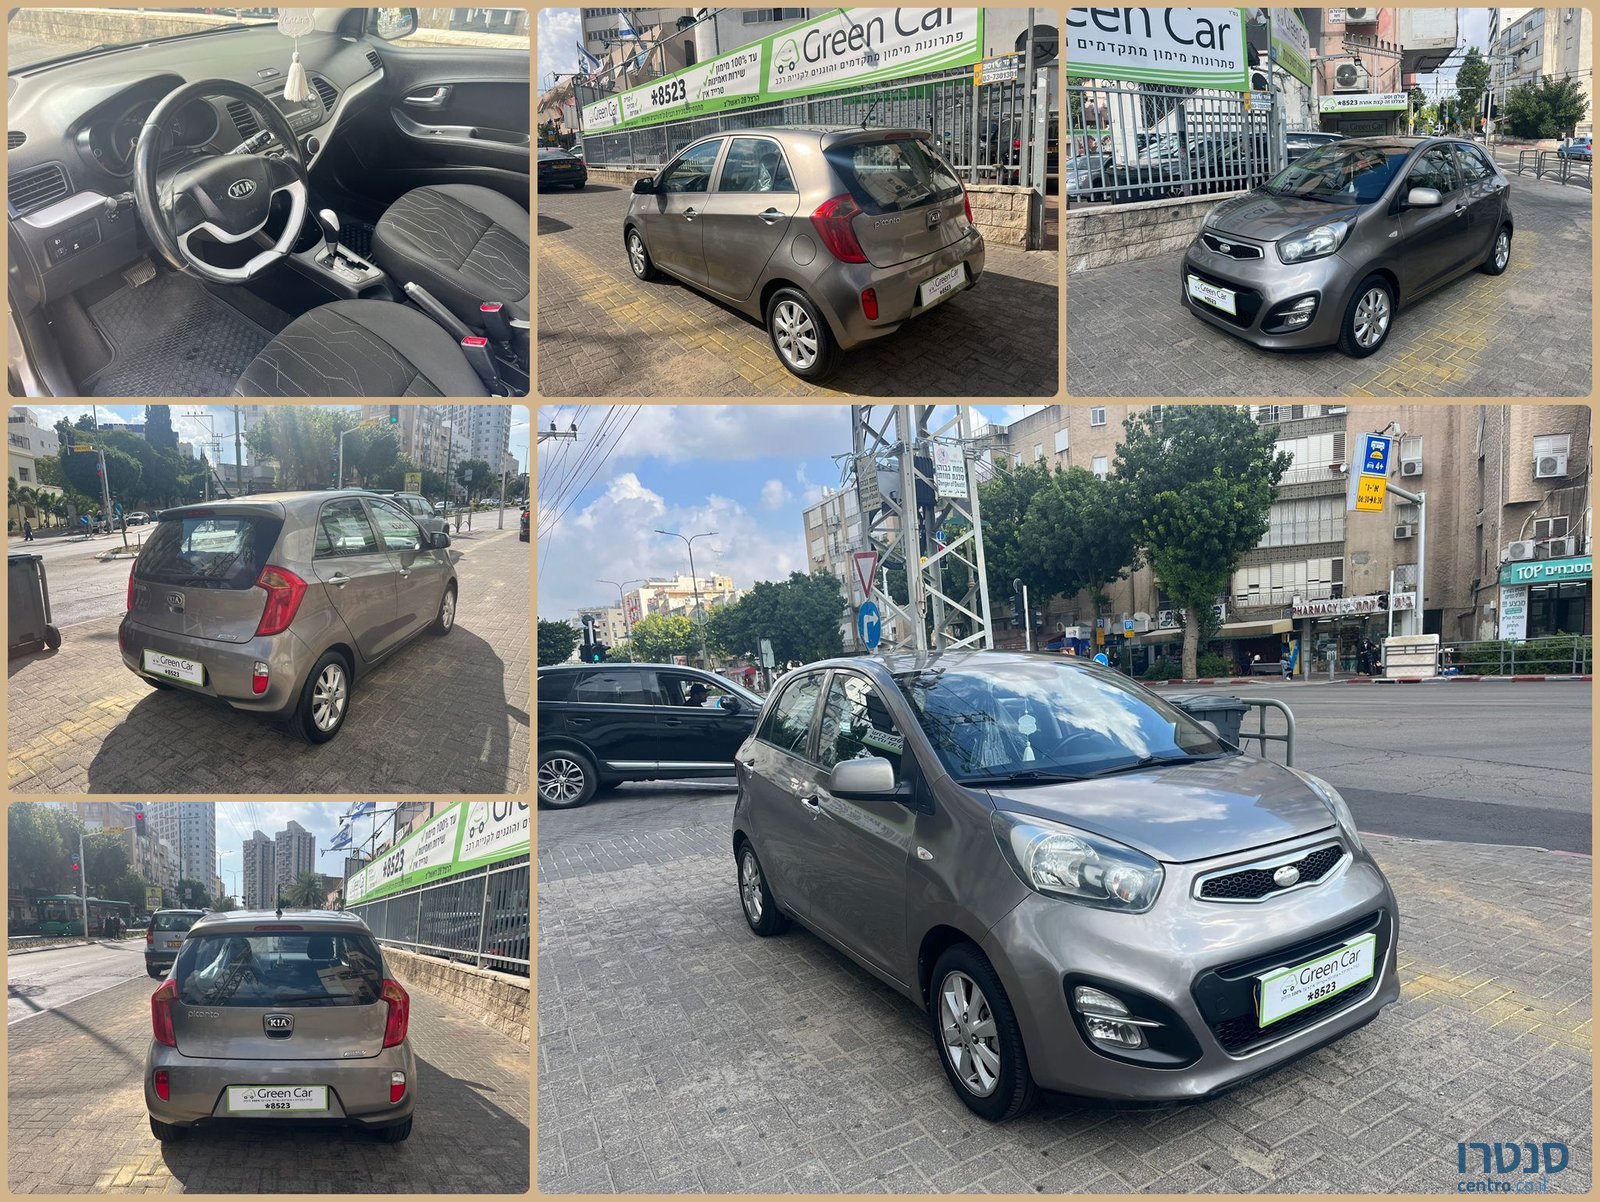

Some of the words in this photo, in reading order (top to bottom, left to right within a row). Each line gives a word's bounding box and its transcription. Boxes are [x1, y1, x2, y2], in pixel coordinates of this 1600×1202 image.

[1164, 8, 1231, 51] Car
[803, 14, 884, 63] Green
[915, 32, 963, 51] פתרונות
[884, 45, 910, 61] מימון
[1077, 38, 1148, 57] מתקדמים
[731, 55, 748, 68] 100%
[748, 52, 758, 62] עד
[840, 53, 880, 69] מתקדמים
[1153, 49, 1187, 62] מימון
[1191, 54, 1235, 70] פתרונות
[715, 63, 730, 75] מימון
[728, 69, 746, 81] שירות
[787, 70, 809, 82] לקניית
[811, 64, 837, 76] והוגנים
[707, 73, 728, 86] ואמינות
[775, 77, 786, 85] רכב
[702, 89, 710, 100] אין
[710, 86, 724, 96] טרייד
[594, 106, 608, 120] Green
[232, 181, 253, 197] KIA
[934, 273, 951, 287] Green
[950, 268, 959, 278] Car
[1200, 284, 1216, 296] Green
[1217, 291, 1227, 300] Car
[1517, 565, 1543, 580] TOP
[1292, 603, 1338, 615] PHARMACY
[160, 655, 179, 667] Green
[181, 660, 193, 671] Car
[437, 818, 449, 834] 100%
[450, 813, 457, 825] עד
[496, 822, 520, 839] והוגנים
[432, 834, 446, 848] שירות
[465, 841, 474, 851] רכב
[475, 832, 494, 847] לקניית
[1299, 960, 1338, 985] Green
[1341, 949, 1361, 967] Car
[188, 1009, 220, 1018] picanto
[270, 1019, 287, 1027] KIA
[257, 1088, 291, 1099] Green
[293, 1087, 312, 1098] Car
